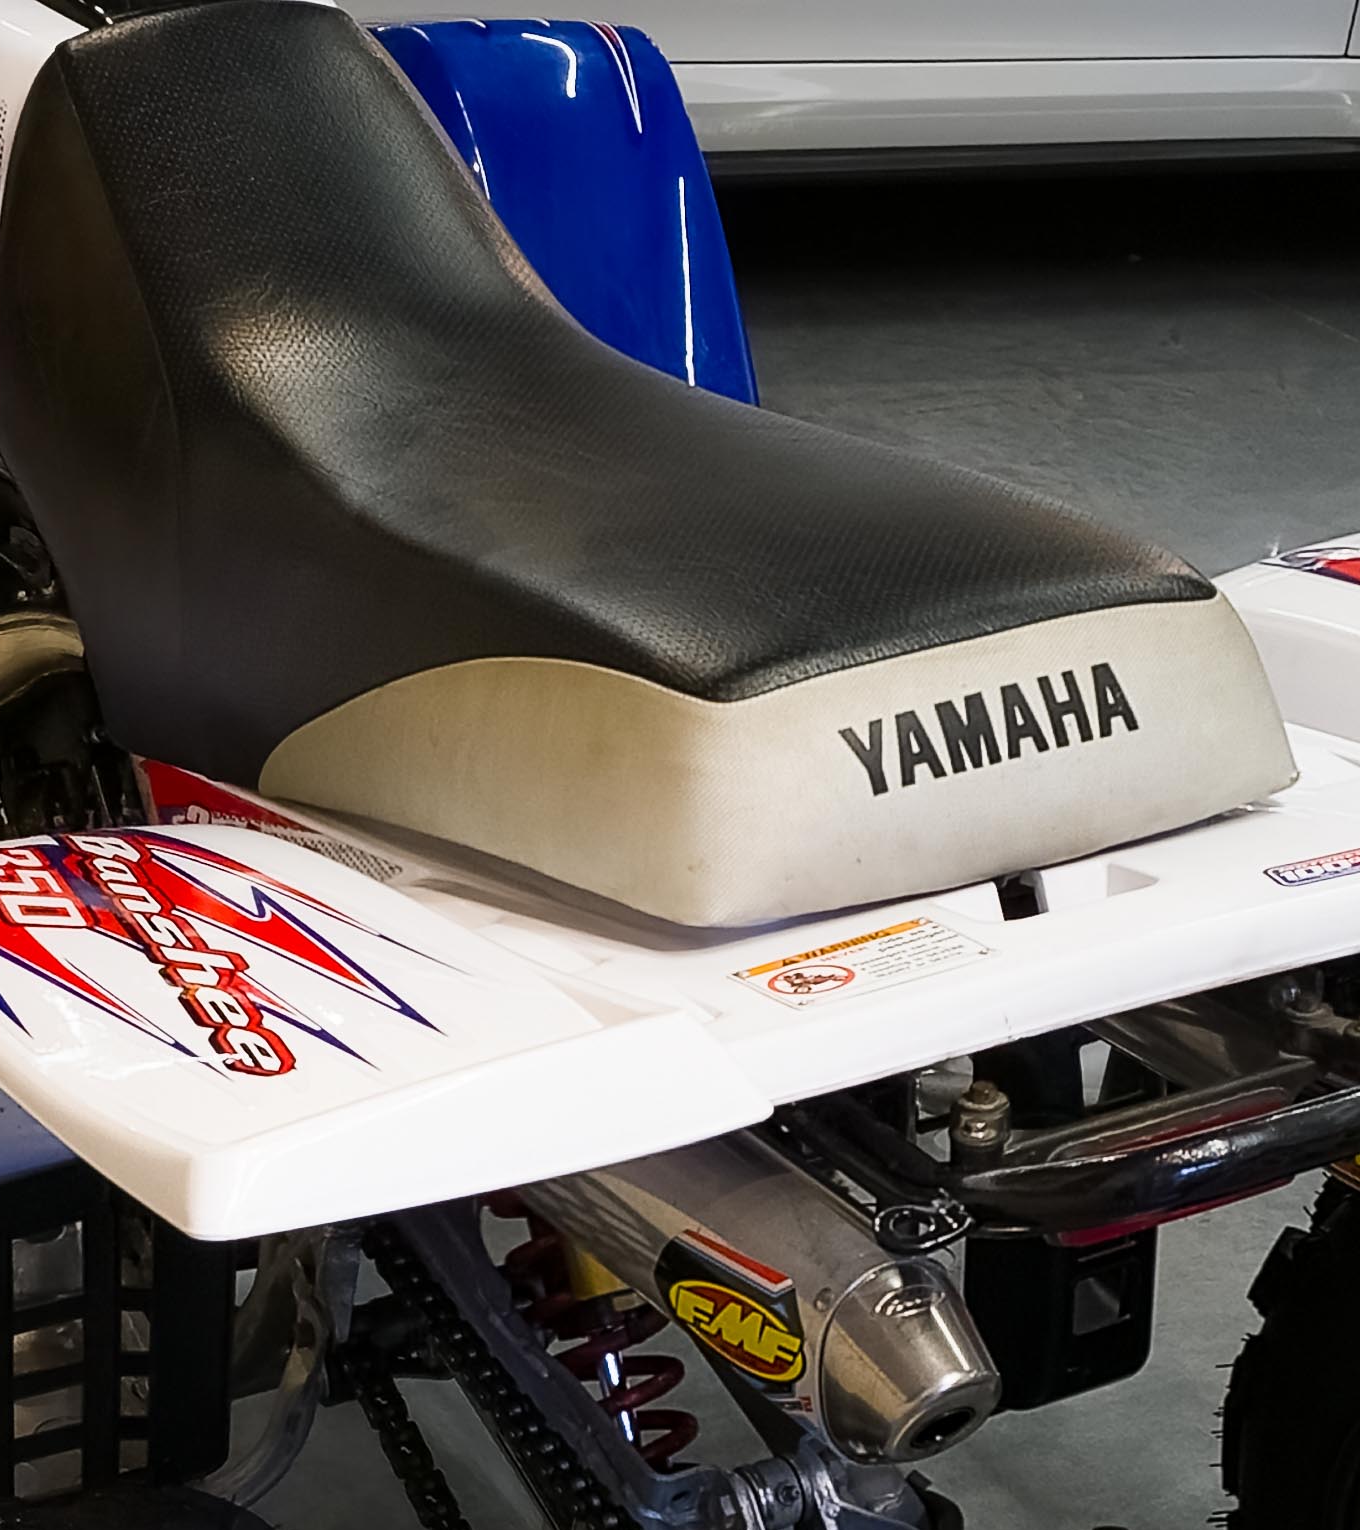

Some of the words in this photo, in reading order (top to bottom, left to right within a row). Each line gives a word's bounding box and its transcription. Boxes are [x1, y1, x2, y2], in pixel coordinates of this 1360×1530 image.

[838, 663, 1139, 796] YAMAHA
[68, 834, 292, 1075] Banshee
[675, 1286, 801, 1366] FMF
